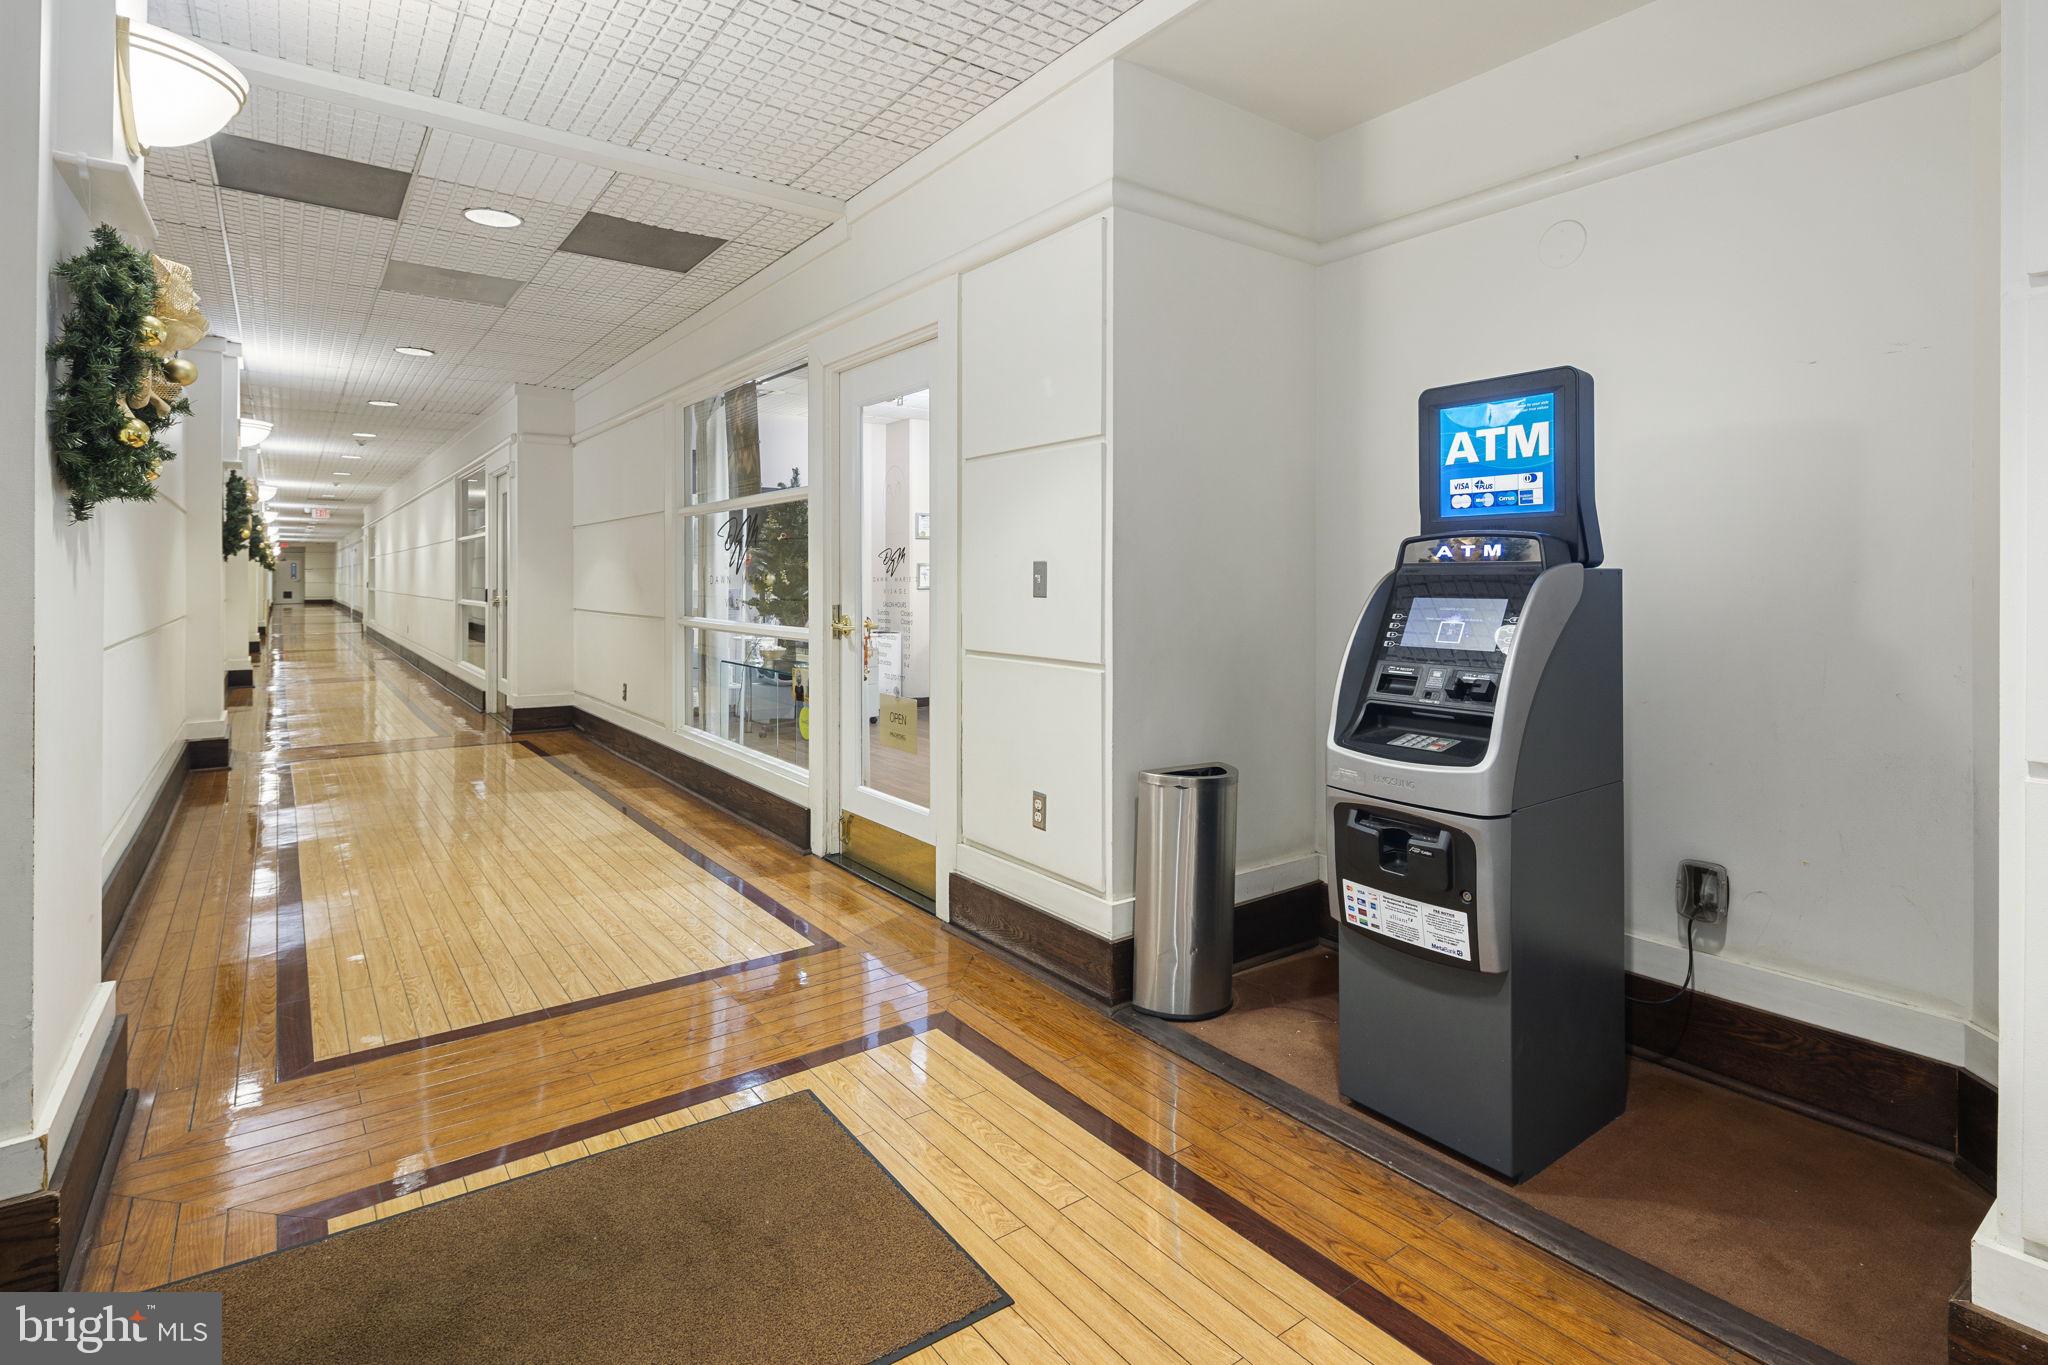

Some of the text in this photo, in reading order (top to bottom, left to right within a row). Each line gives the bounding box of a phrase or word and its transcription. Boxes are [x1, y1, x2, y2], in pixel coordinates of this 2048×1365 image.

[1445, 421, 1550, 466] ATM
[1454, 483, 1470, 491] VISA
[1435, 544, 1502, 559] ATM
[889, 711, 907, 726] OPEN
[1431, 943, 1456, 955] MetaBank
